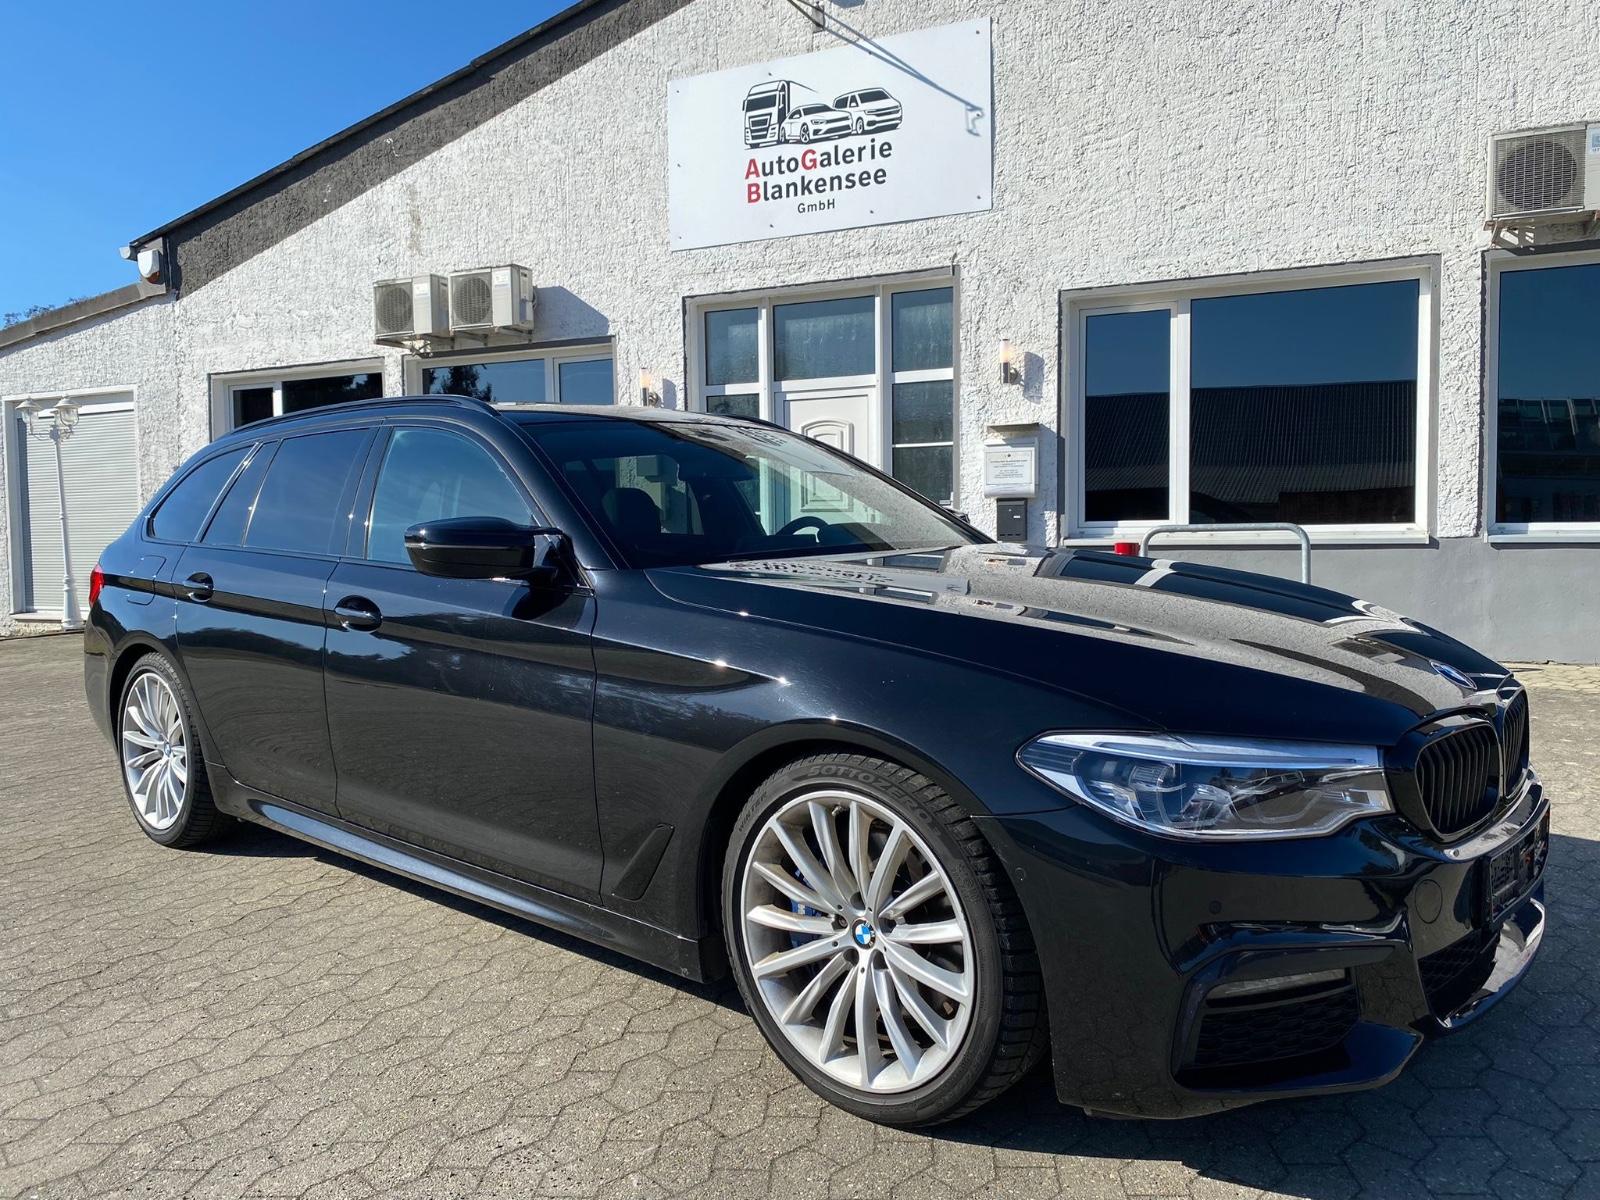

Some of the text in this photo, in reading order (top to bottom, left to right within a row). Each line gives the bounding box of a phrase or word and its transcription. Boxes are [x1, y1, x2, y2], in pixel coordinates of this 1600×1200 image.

[745, 138, 893, 180] AutoGalerie
[747, 168, 887, 204] Blankensee
[797, 198, 835, 214] GmbH
